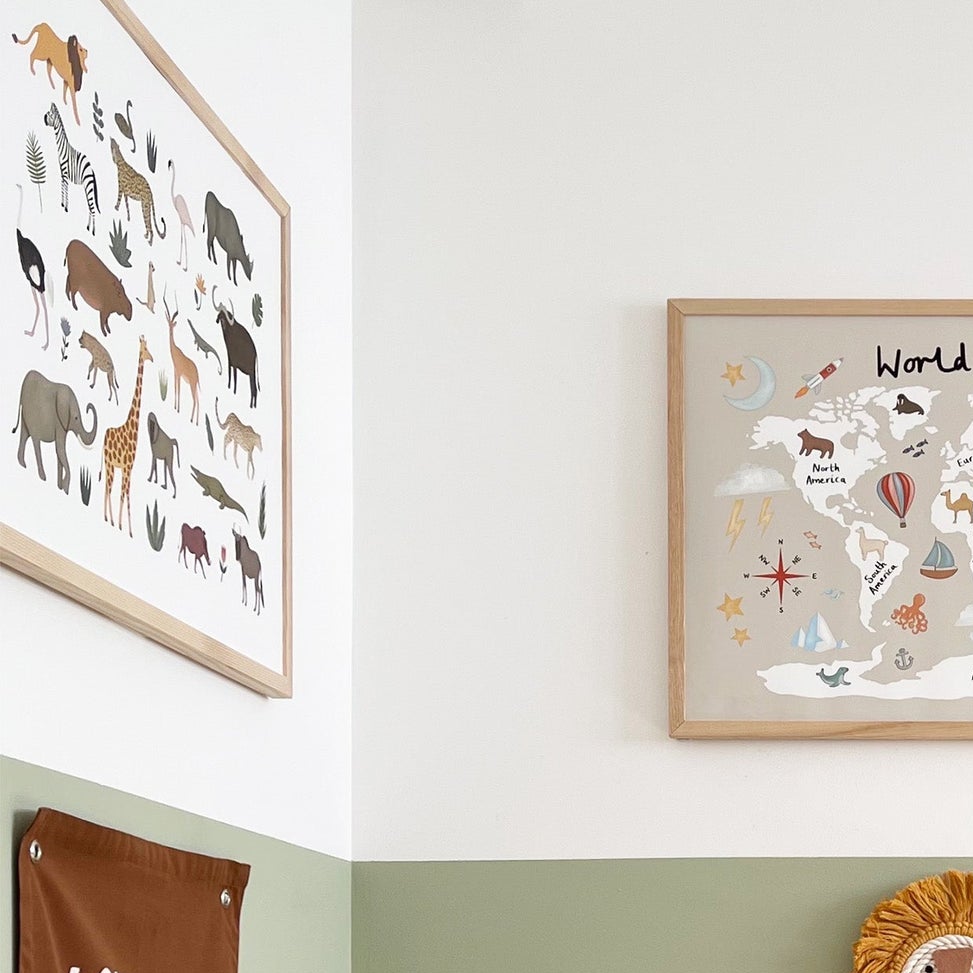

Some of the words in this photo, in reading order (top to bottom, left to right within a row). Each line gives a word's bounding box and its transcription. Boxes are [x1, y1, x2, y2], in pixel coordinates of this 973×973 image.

[877, 342, 972, 379] World
[812, 462, 840, 473] North
[806, 474, 847, 485] America
[778, 538, 785, 546] N
[812, 572, 818, 580] E
[864, 560, 887, 584] South
[868, 564, 898, 596] America
[779, 606, 785, 614] S
